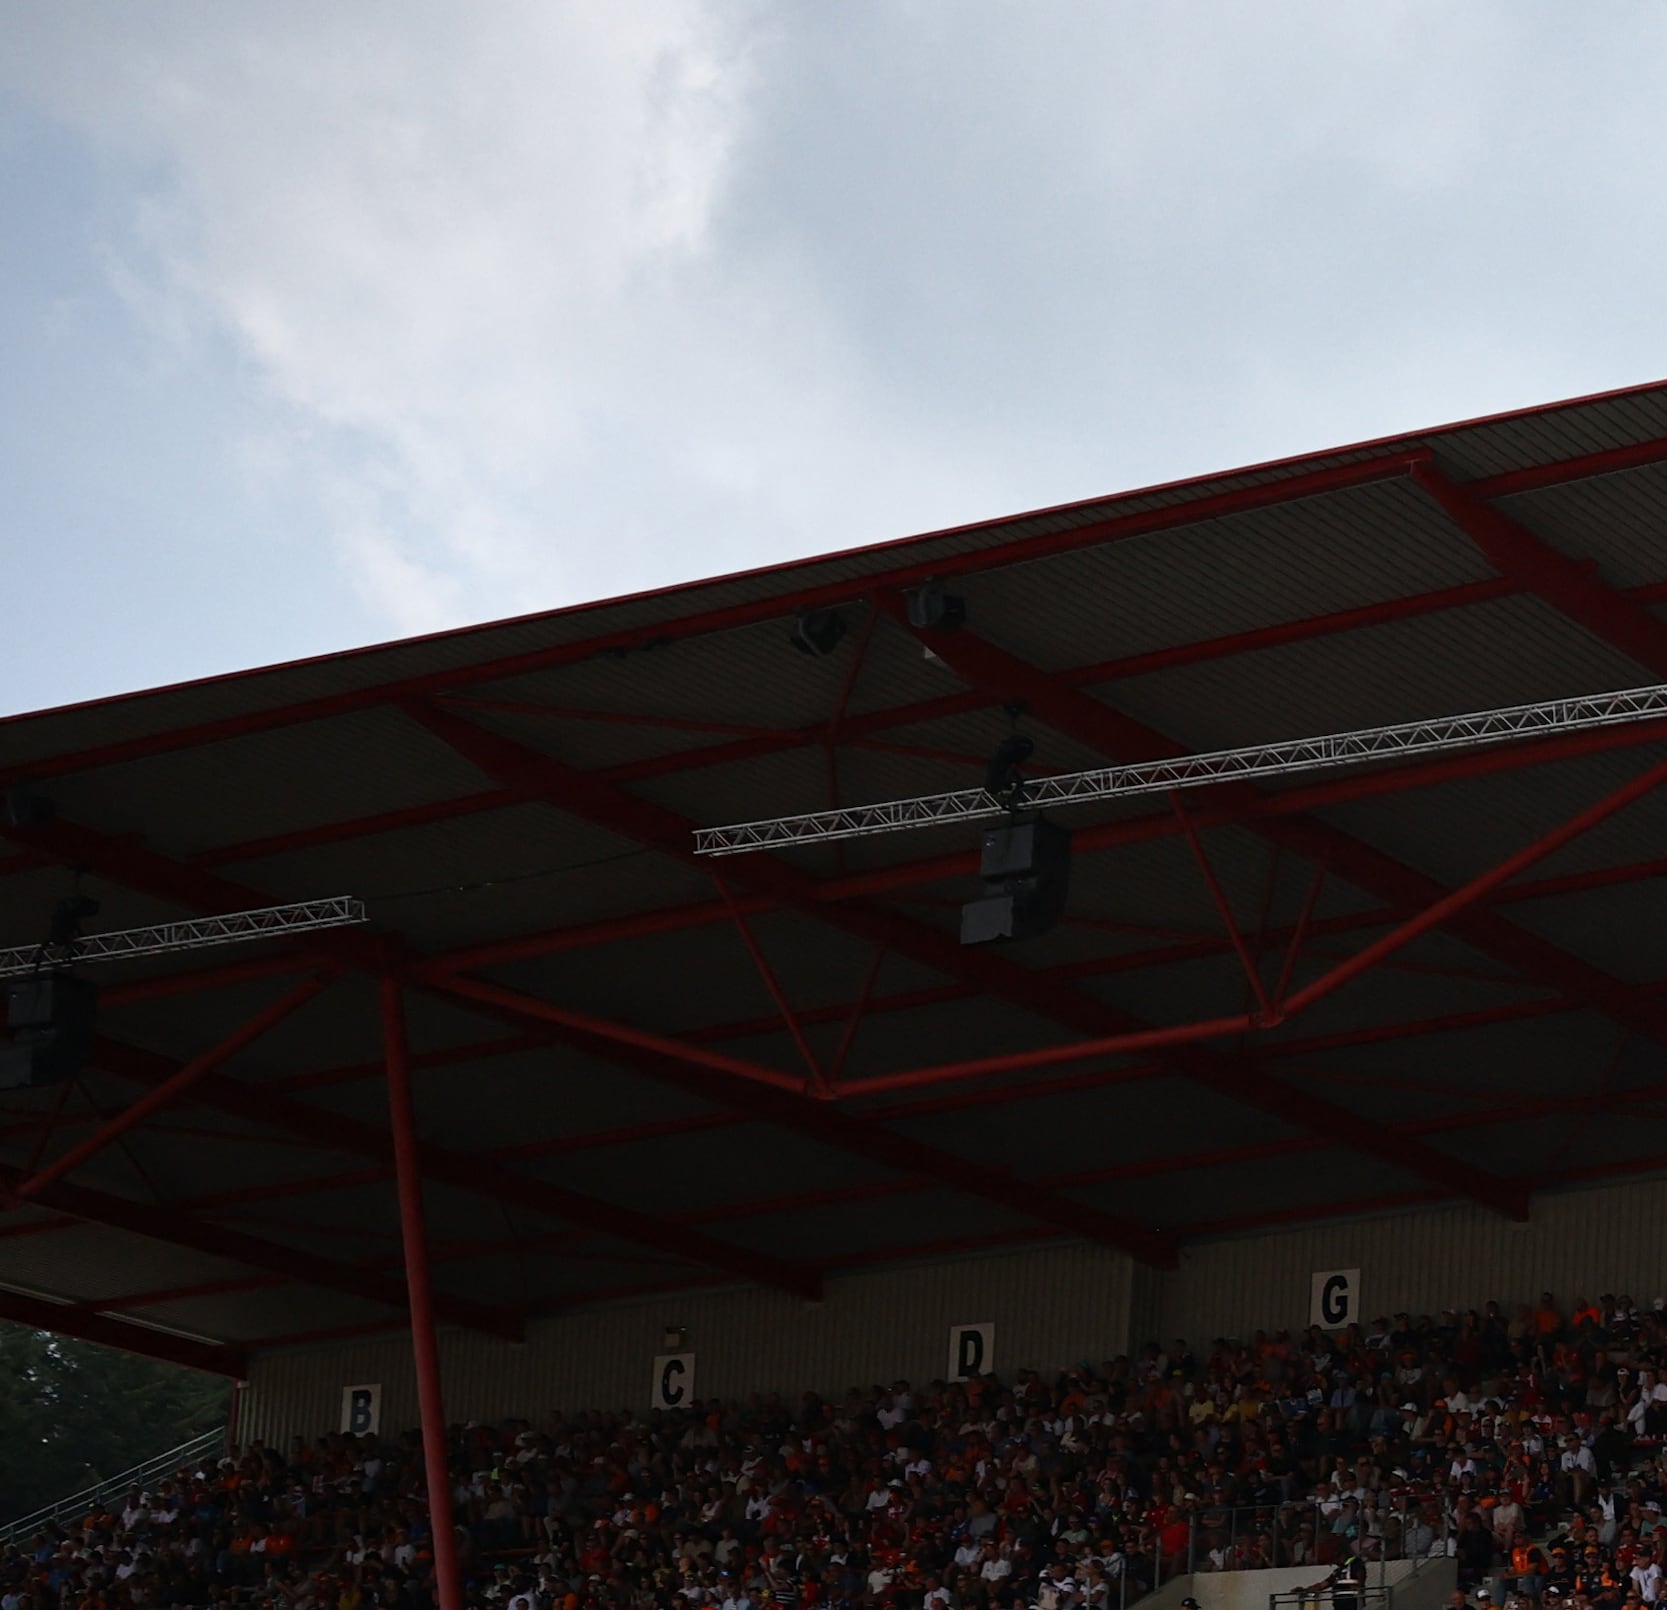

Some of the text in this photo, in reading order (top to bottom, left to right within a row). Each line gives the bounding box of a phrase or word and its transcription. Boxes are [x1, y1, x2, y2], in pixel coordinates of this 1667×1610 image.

[1322, 1275, 1349, 1324] G
[960, 1330, 983, 1376] D
[661, 1360, 686, 1403] C
[351, 1390, 373, 1433] B
